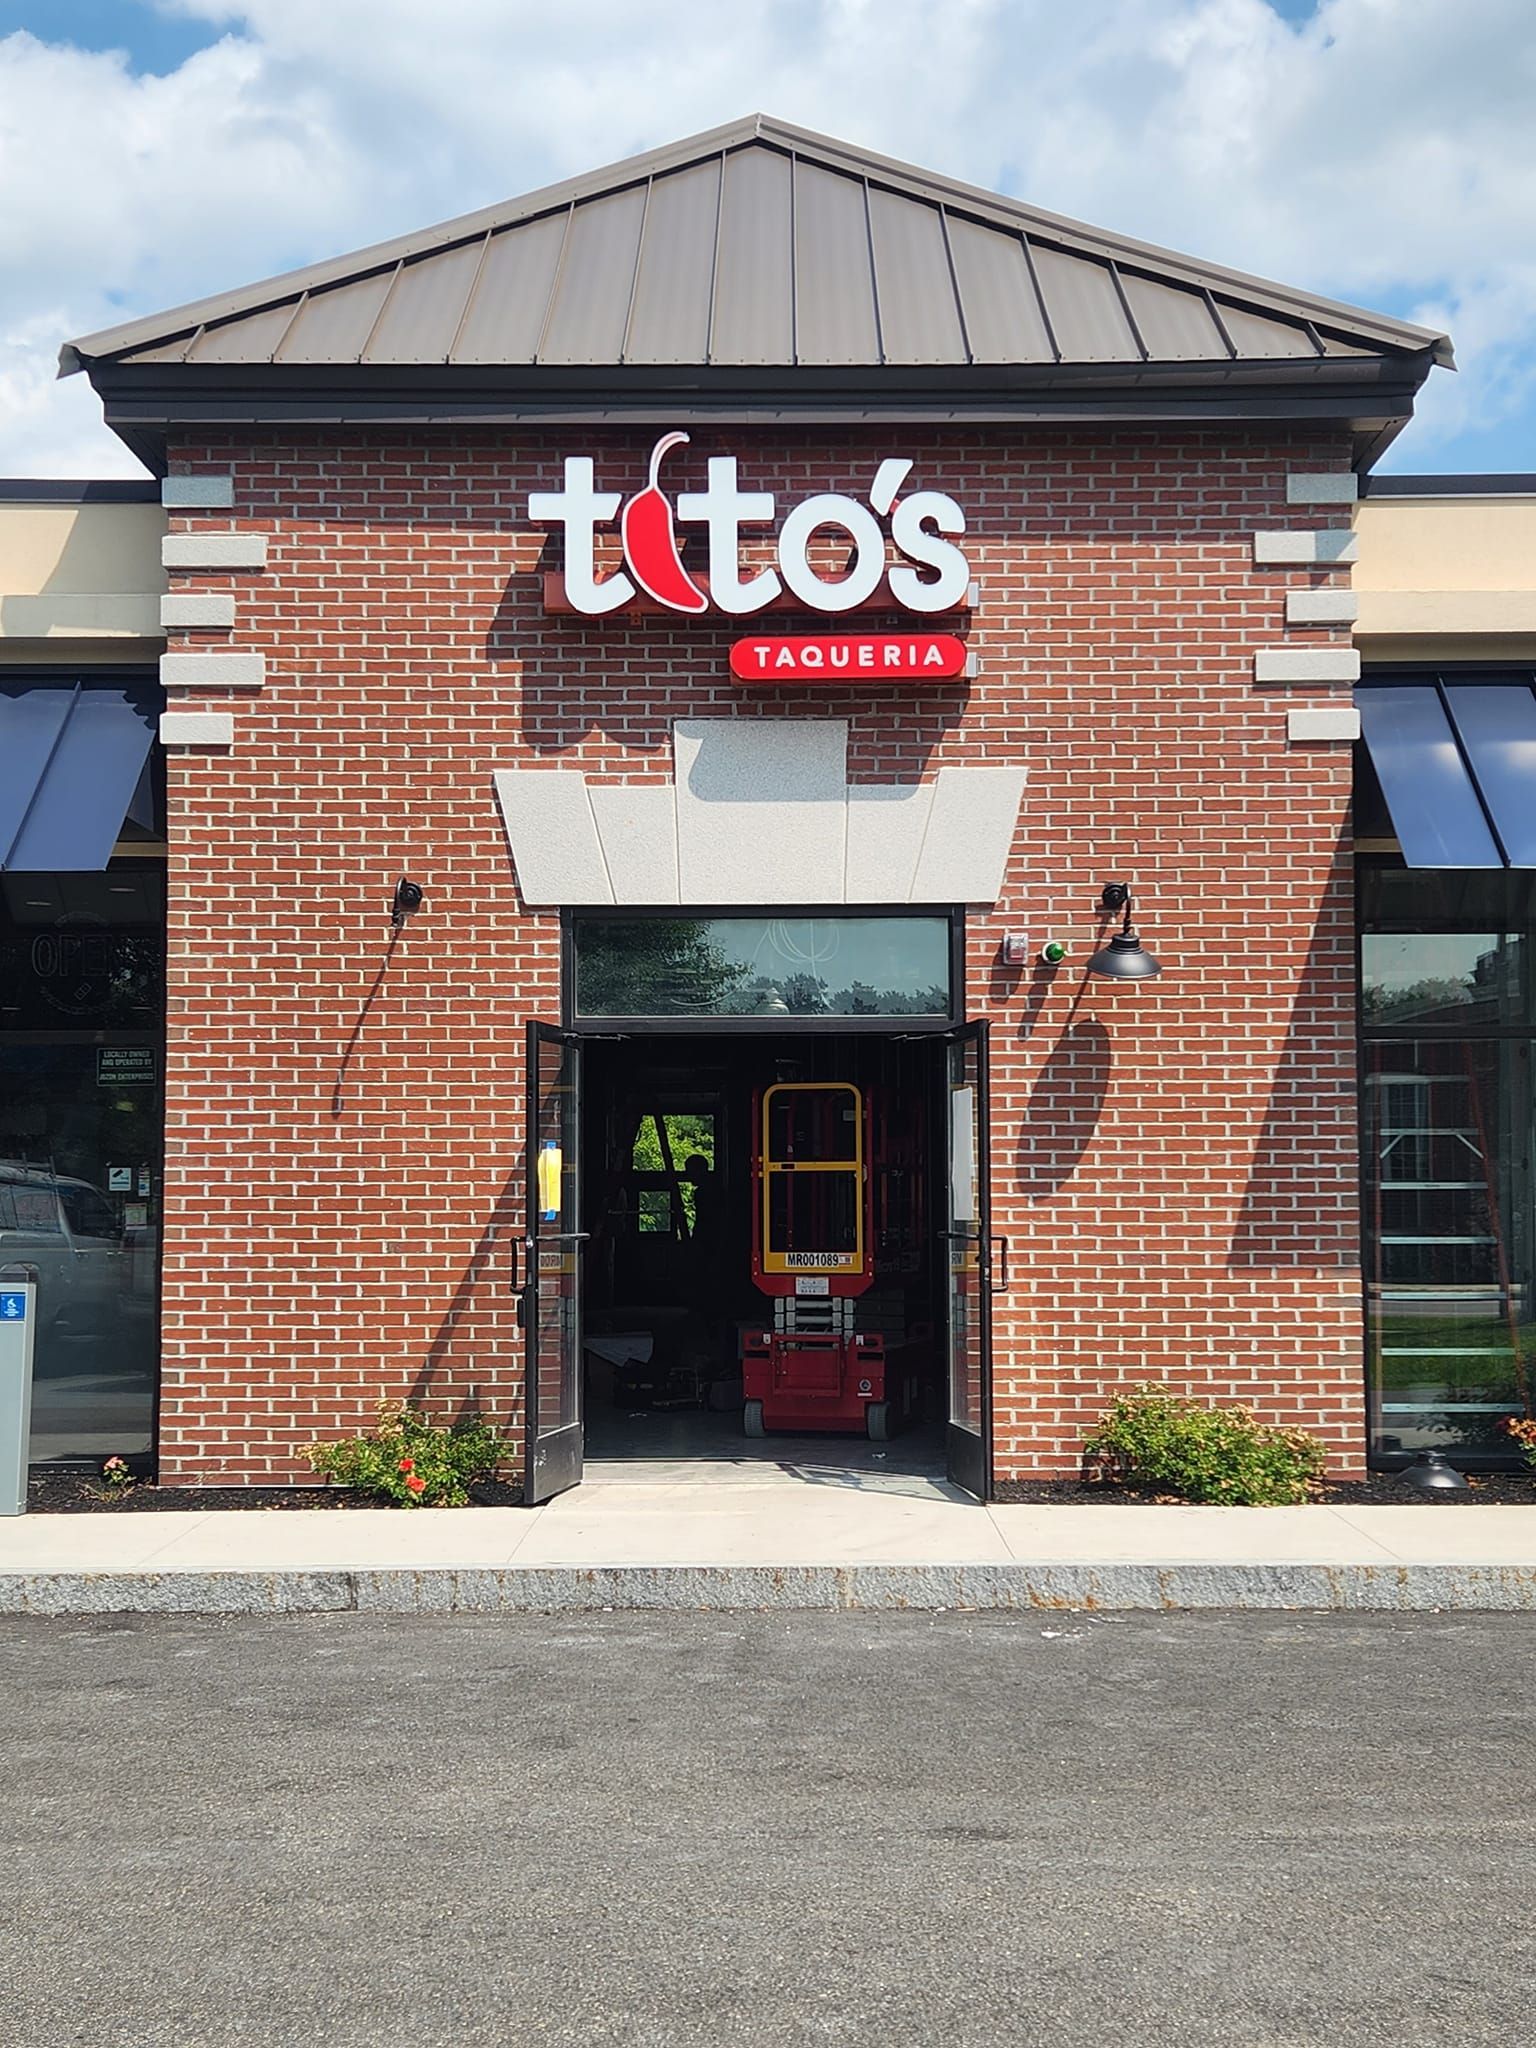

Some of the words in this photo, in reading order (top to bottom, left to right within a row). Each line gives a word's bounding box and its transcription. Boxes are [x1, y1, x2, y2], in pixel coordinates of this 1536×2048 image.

[753, 644, 944, 669] TAQUERIA
[31, 934, 118, 977] OPE
[787, 1253, 839, 1267] MR001089
